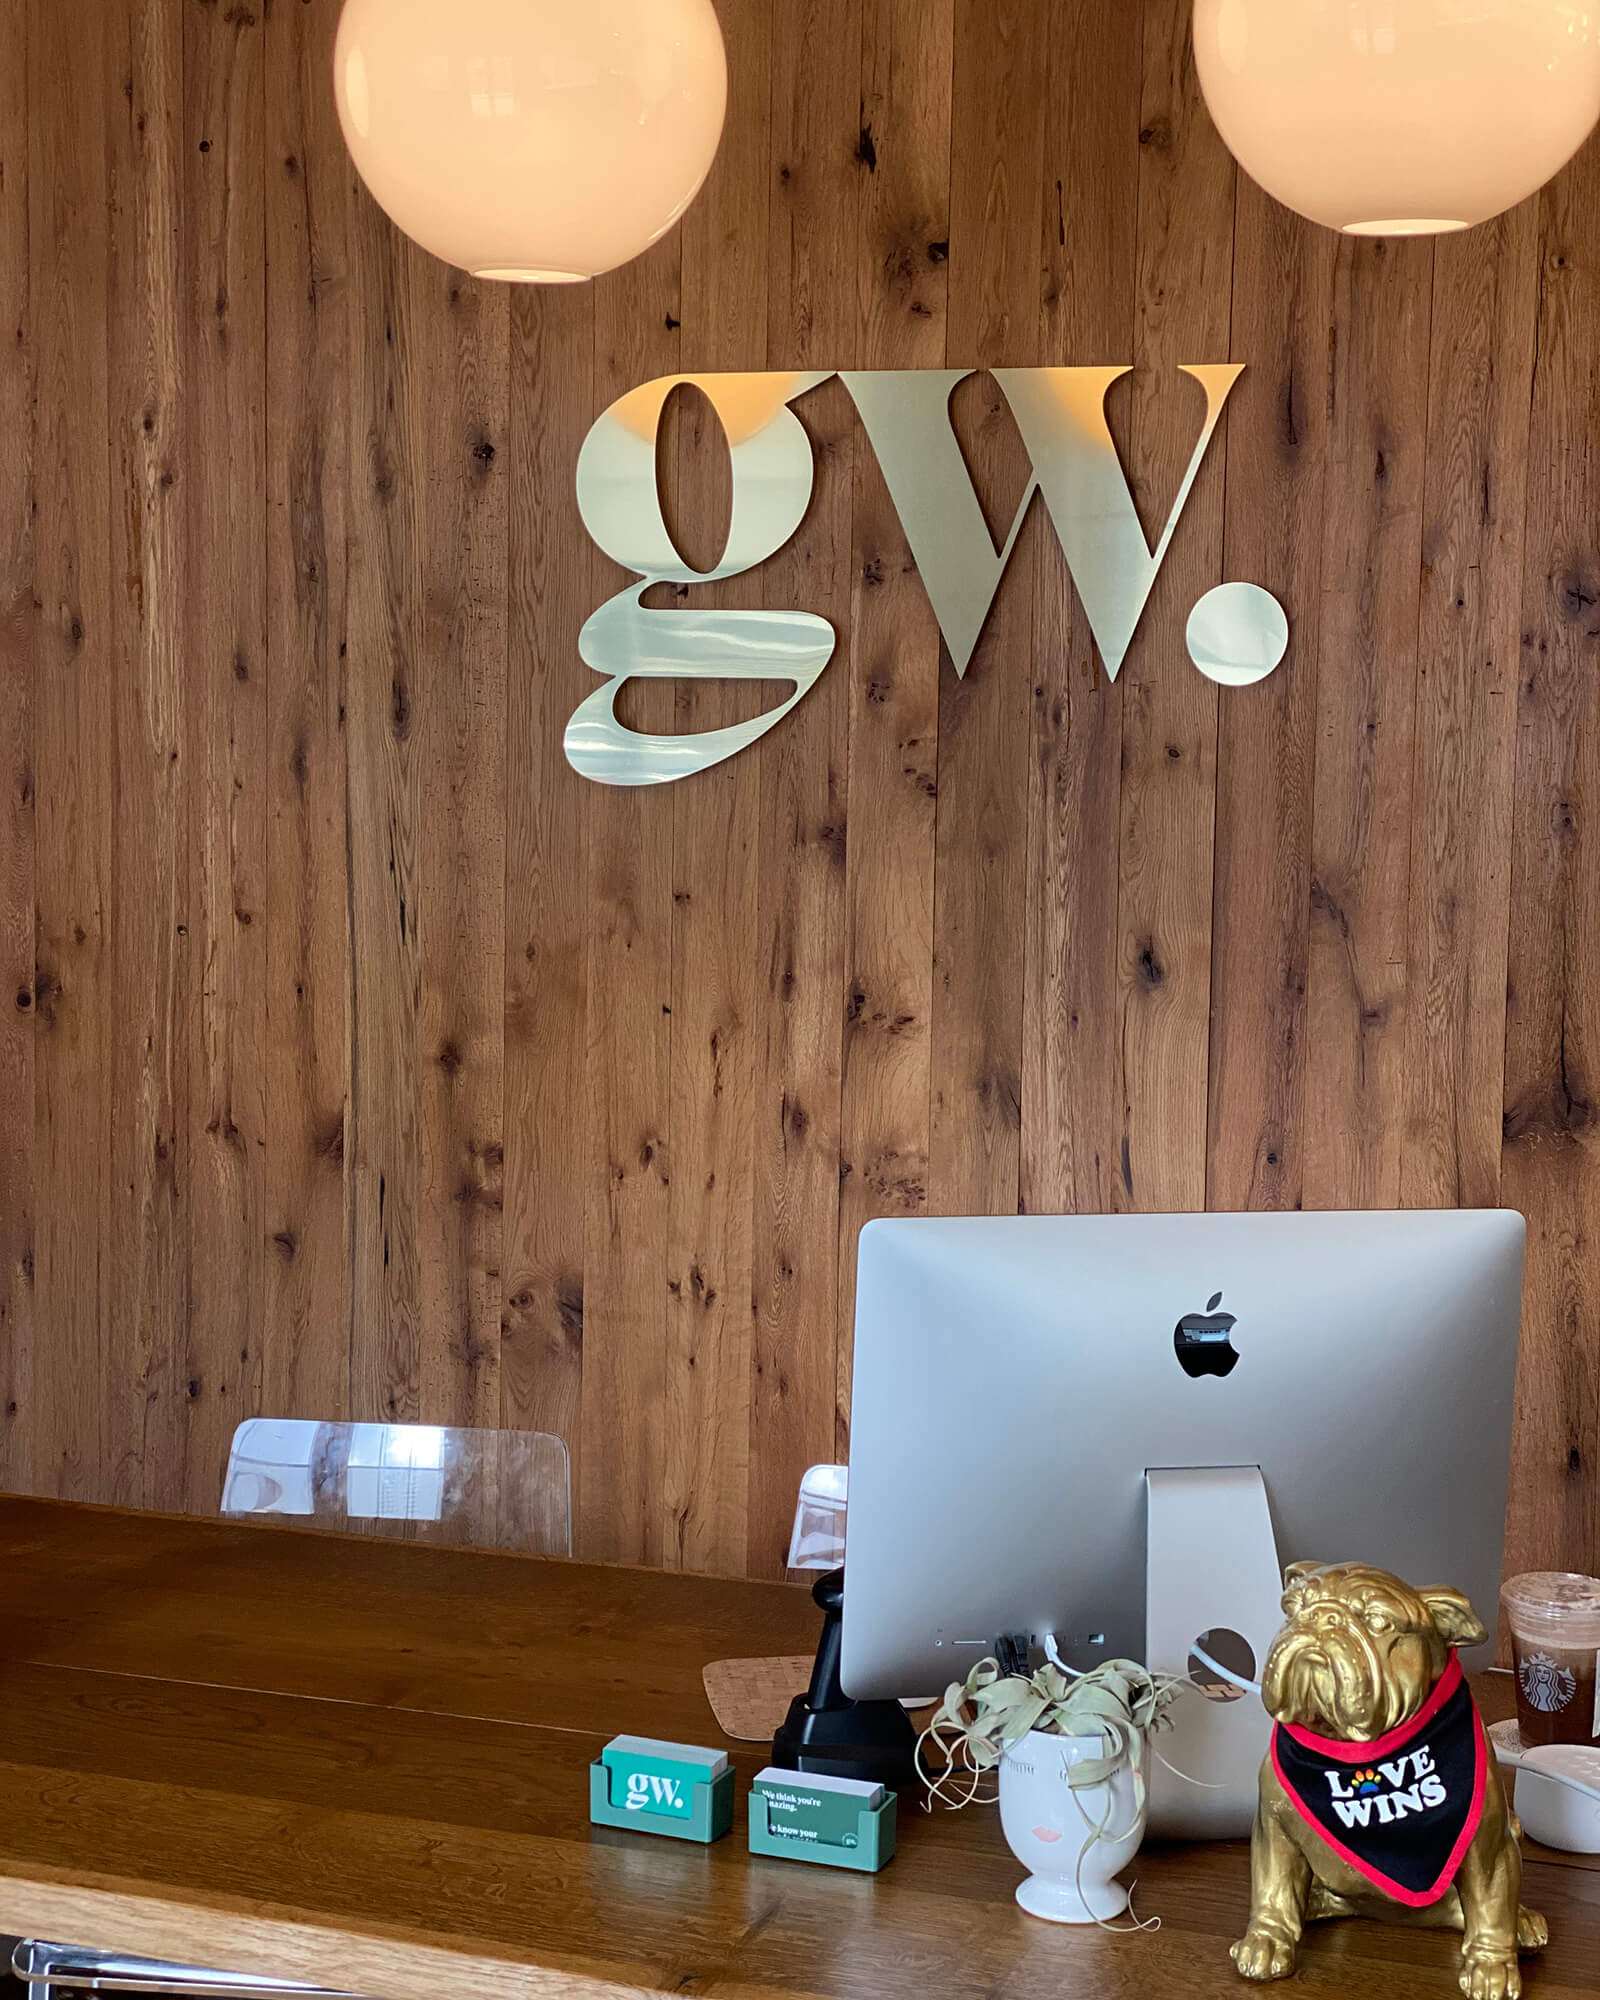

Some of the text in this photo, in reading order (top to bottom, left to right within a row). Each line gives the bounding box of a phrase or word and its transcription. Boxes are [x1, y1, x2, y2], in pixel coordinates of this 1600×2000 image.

[563, 363, 1289, 787] gw.
[625, 1773, 684, 1810] gw.
[776, 1792, 798, 1803] think
[798, 1796, 822, 1807] you're
[1331, 1774, 1447, 1828] WINS
[777, 1824, 799, 1835] know
[799, 1829, 819, 1839] your
